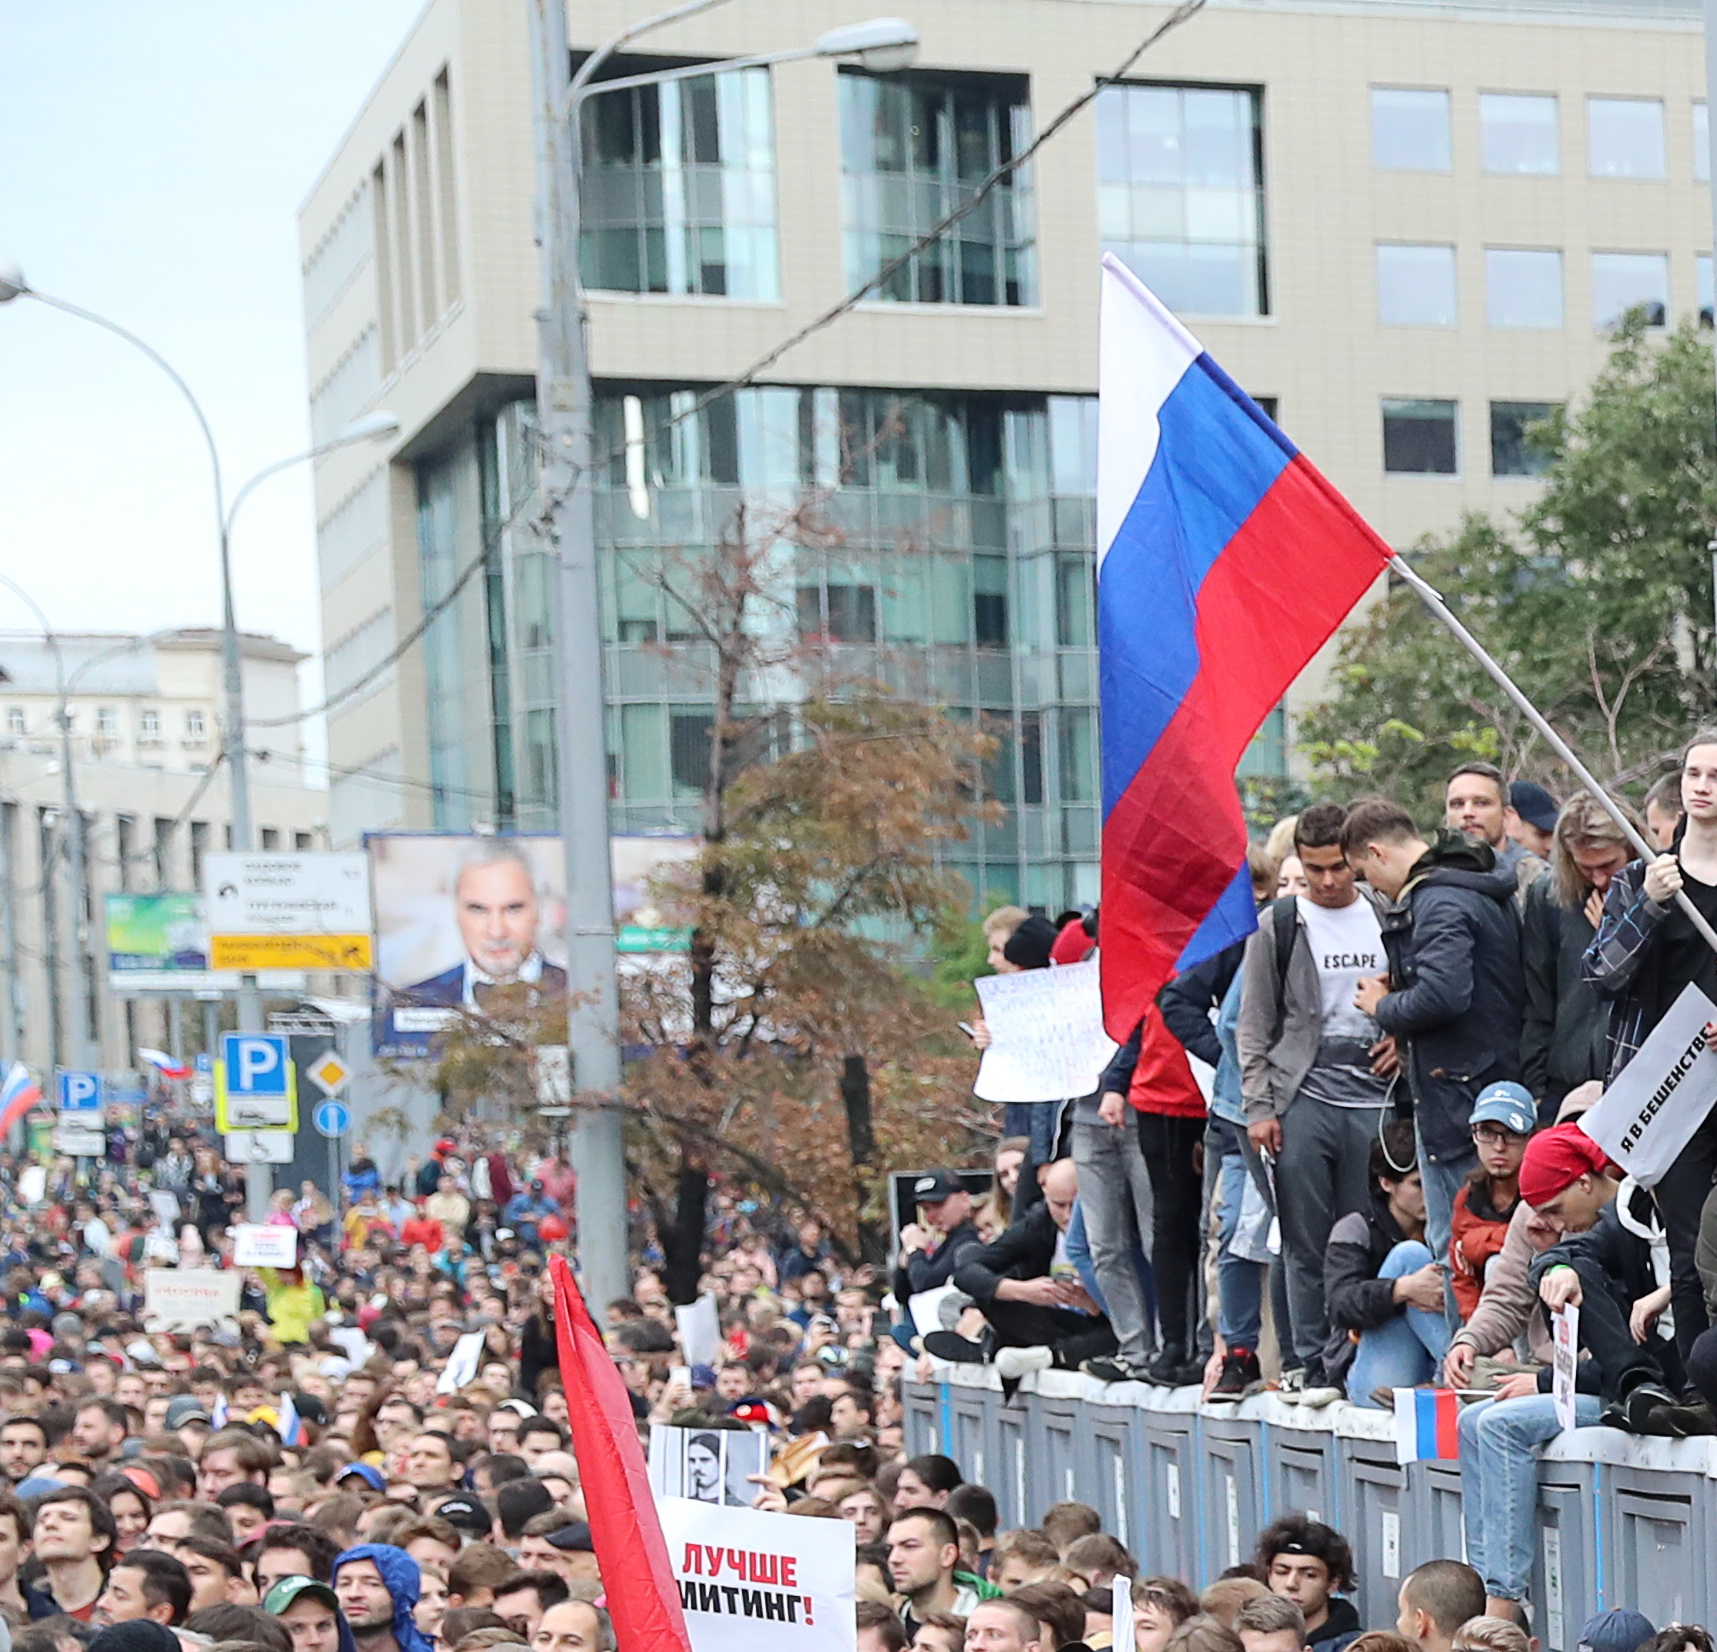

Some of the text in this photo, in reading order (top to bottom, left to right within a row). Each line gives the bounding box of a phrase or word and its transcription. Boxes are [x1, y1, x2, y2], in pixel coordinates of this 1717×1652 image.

[1324, 953, 1377, 969] ESCAPE
[239, 1039, 279, 1090] P
[1620, 1137, 1634, 1154] Я
[1629, 1122, 1643, 1140] В
[683, 1543, 798, 1588] ЛУЧШЕ
